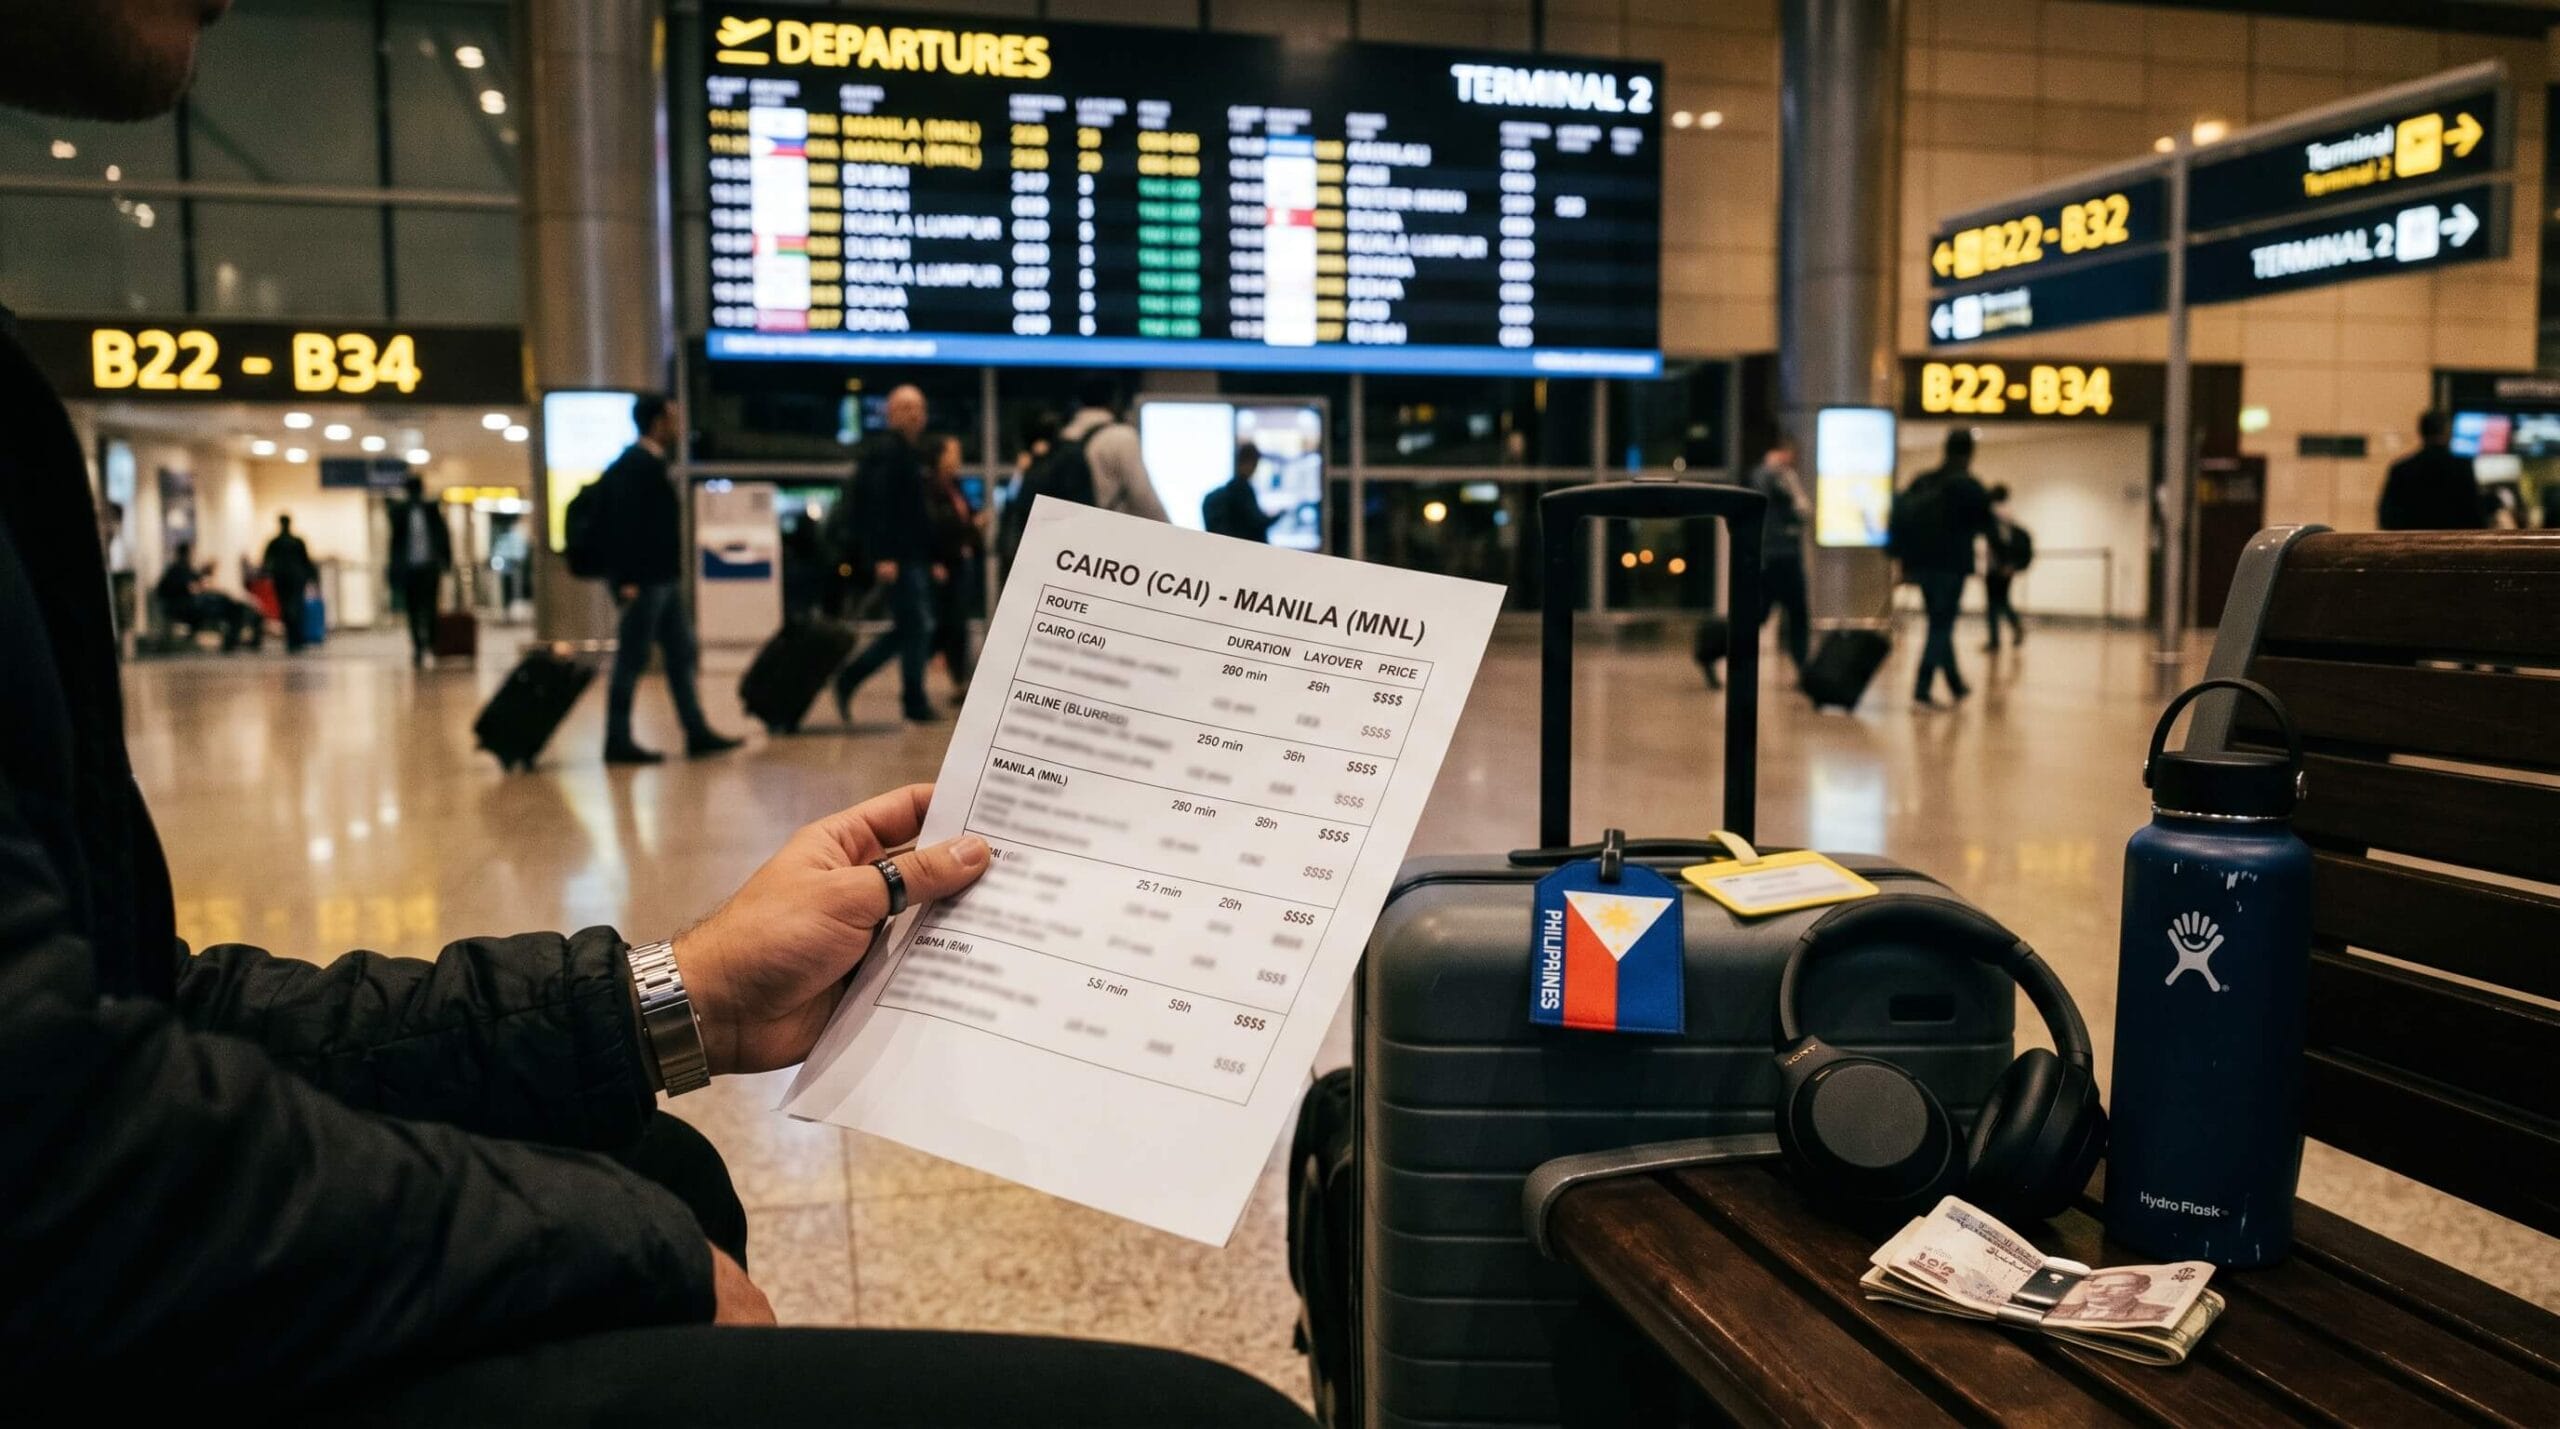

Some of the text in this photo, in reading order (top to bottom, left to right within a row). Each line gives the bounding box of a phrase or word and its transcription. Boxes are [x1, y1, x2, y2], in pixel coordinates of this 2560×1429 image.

[776, 20, 1052, 79] DEPARTURES
[1451, 62, 1654, 114] TERMINAL 2
[2305, 123, 2395, 172] Terminal
[2250, 222, 2395, 280] TERMINAL 2
[91, 328, 222, 391] B22
[292, 332, 422, 395] B34
[1045, 594, 1089, 615] ROUTE
[1056, 549, 1140, 586] CAIRO
[1147, 570, 1210, 608] (CAI)
[1233, 588, 1338, 628] MANILA
[1346, 609, 1426, 647] (MNL)
[1037, 621, 1106, 650] CAIRO (CAI)
[1227, 635, 1292, 657] DURATION
[1303, 650, 1364, 671] LAYOVER
[1378, 663, 1419, 680] PRICE
[1245, 668, 1268, 682] min
[1014, 690, 1061, 711] AIRLINE
[1197, 733, 1244, 752] 250 min
[992, 757, 1069, 787] MANILA (MNL)
[1171, 799, 1217, 818] 280 min
[1160, 885, 1182, 899] min
[1105, 983, 1129, 997] min
[2140, 1190, 2220, 1217] Hydro Flask
